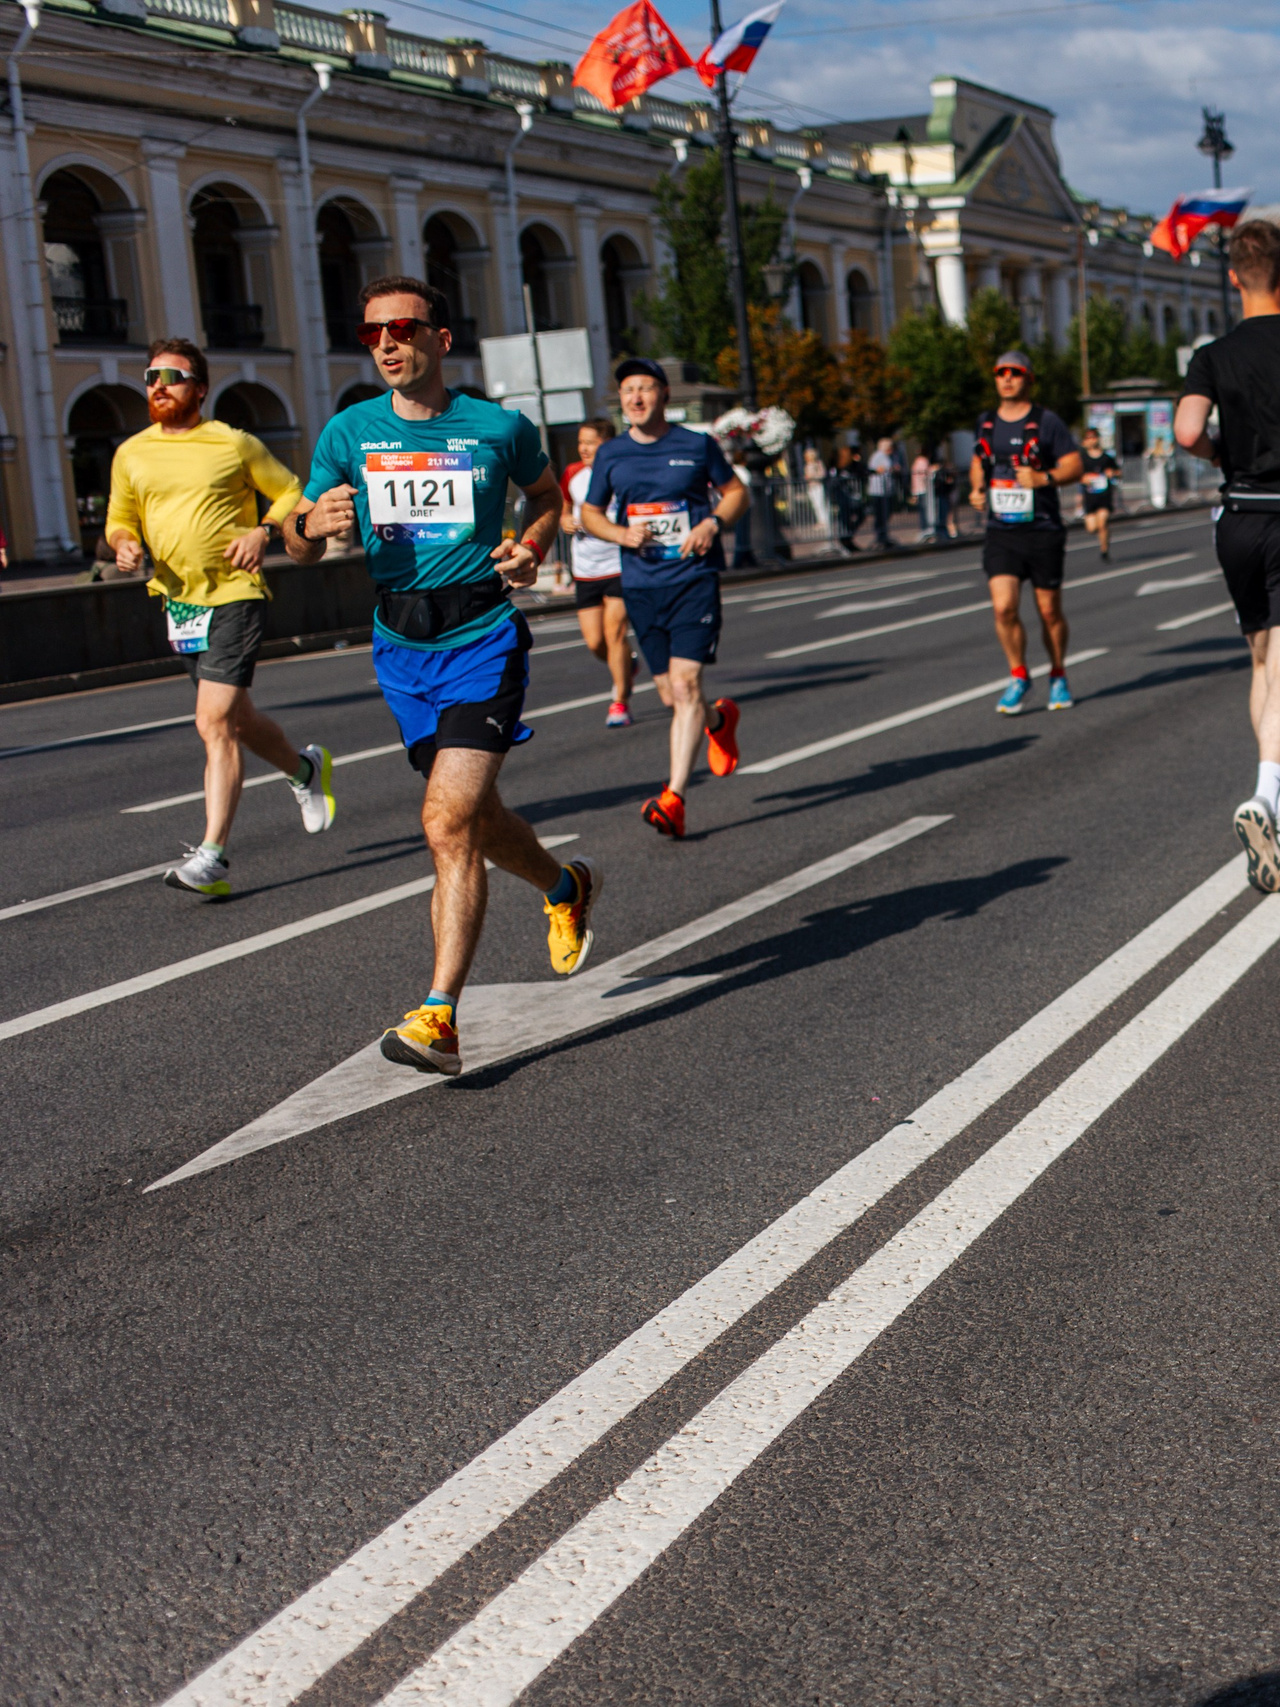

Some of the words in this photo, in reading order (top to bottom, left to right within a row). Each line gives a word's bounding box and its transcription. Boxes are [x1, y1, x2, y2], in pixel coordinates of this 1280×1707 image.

[360, 441, 402, 450] stadium
[446, 438, 479, 446] VITAMIN
[427, 458, 443, 467] 21,1
[384, 479, 456, 507] 1121
[410, 509, 434, 517] ОЛЕГ
